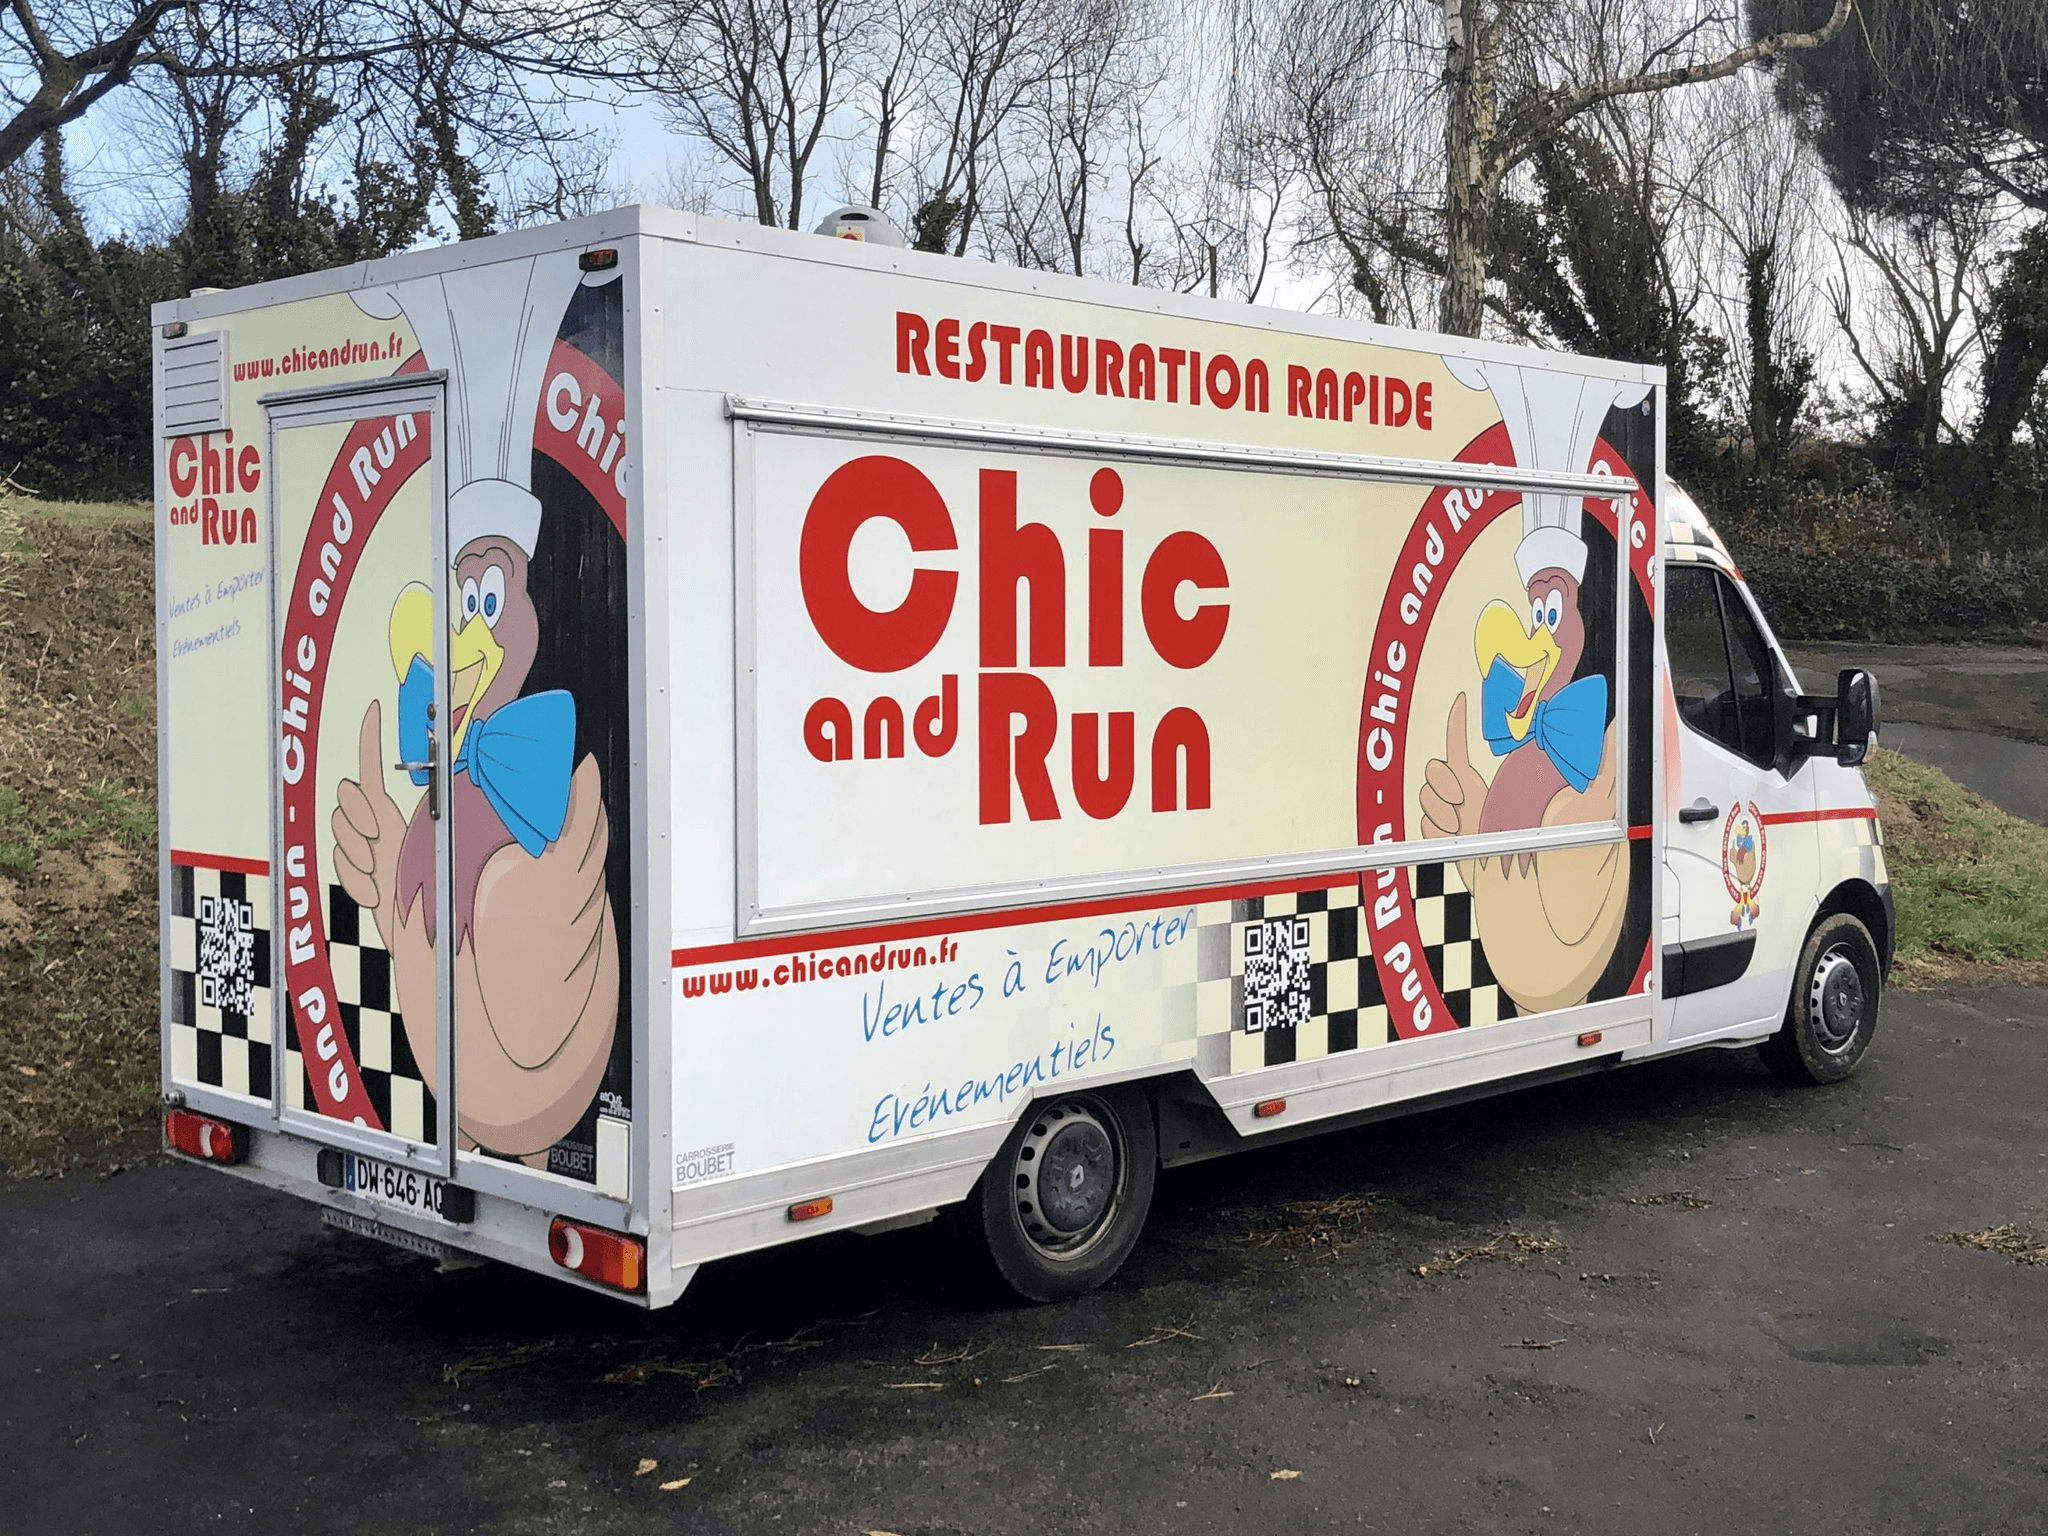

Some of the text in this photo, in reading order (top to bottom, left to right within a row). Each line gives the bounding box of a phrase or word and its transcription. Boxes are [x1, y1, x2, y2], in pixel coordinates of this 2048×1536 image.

[234, 332, 403, 382] www.chicandrun.fr
[896, 311, 1433, 431] RESTAURATION RAPIDE
[169, 429, 261, 498] Chic
[349, 414, 418, 502] Run
[170, 497, 257, 545] and Run
[309, 491, 353, 618] and
[799, 455, 1231, 673] Chic
[1400, 521, 1444, 625] and
[169, 595, 201, 619] Ventes
[281, 634, 317, 785] Chic
[803, 673, 1212, 825] and Run
[1366, 639, 1407, 771] Chic
[286, 844, 317, 966] Run
[682, 937, 958, 999] www.chicandrun.fr
[863, 908, 1195, 1043] Ventes à Emporter
[1384, 941, 1433, 1032] and
[298, 986, 349, 1102] and
[867, 1013, 1116, 1144] Evénementiels
[550, 1147, 594, 1174] BOUBET
[676, 1142, 735, 1165] CARROSSERIE
[676, 1151, 735, 1182] BOUBET
